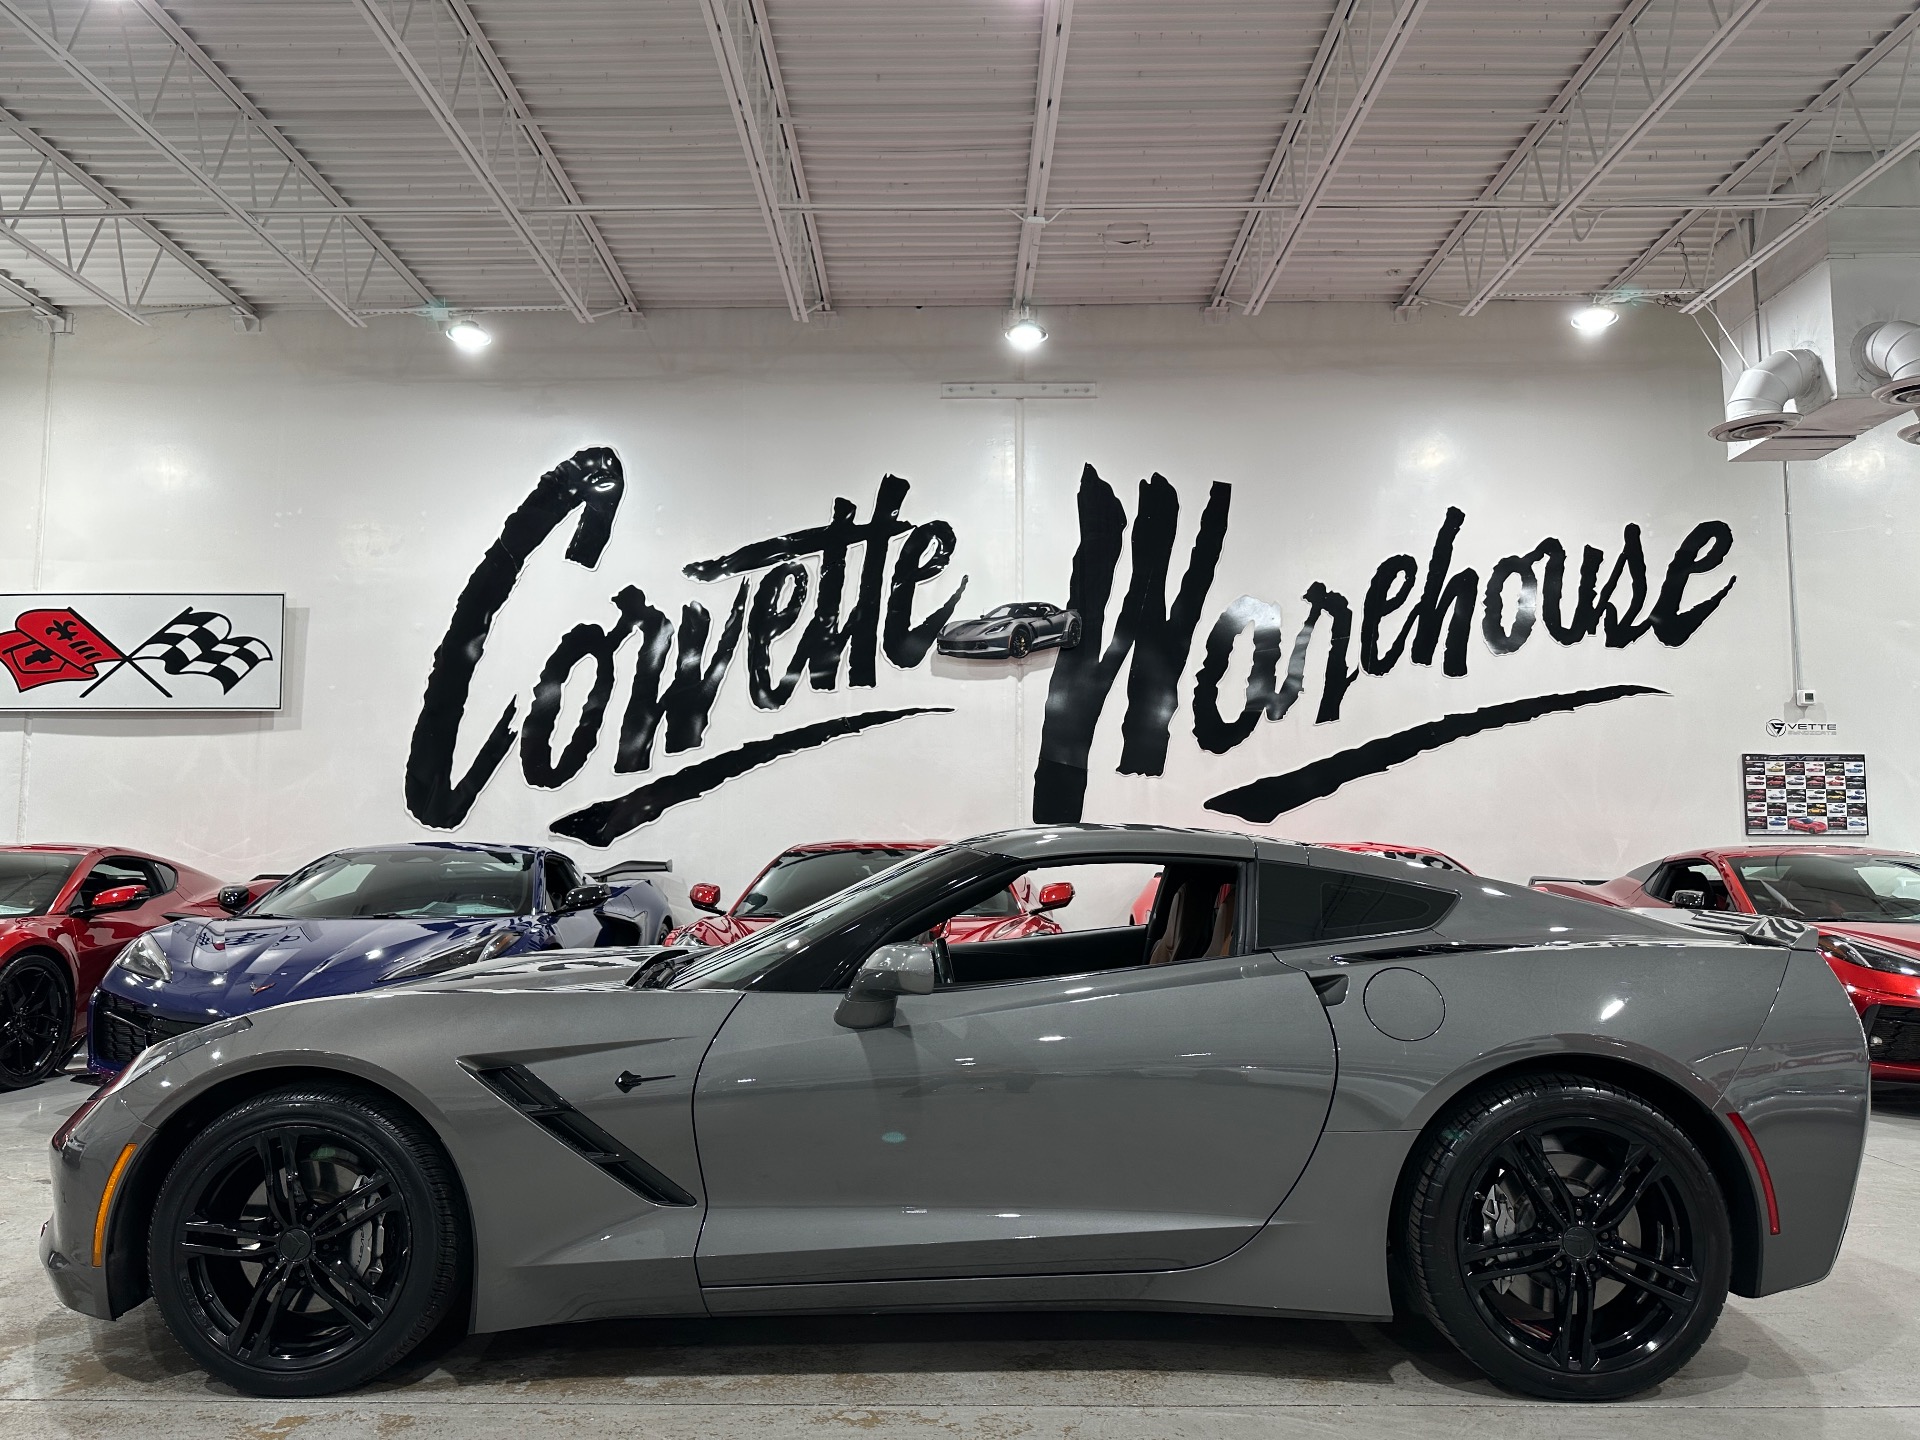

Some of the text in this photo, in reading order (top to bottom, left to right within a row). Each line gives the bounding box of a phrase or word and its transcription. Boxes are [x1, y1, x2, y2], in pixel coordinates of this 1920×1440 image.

[404, 446, 1737, 830] Corvette Warehouse
[1787, 723, 1837, 731] VETTE
